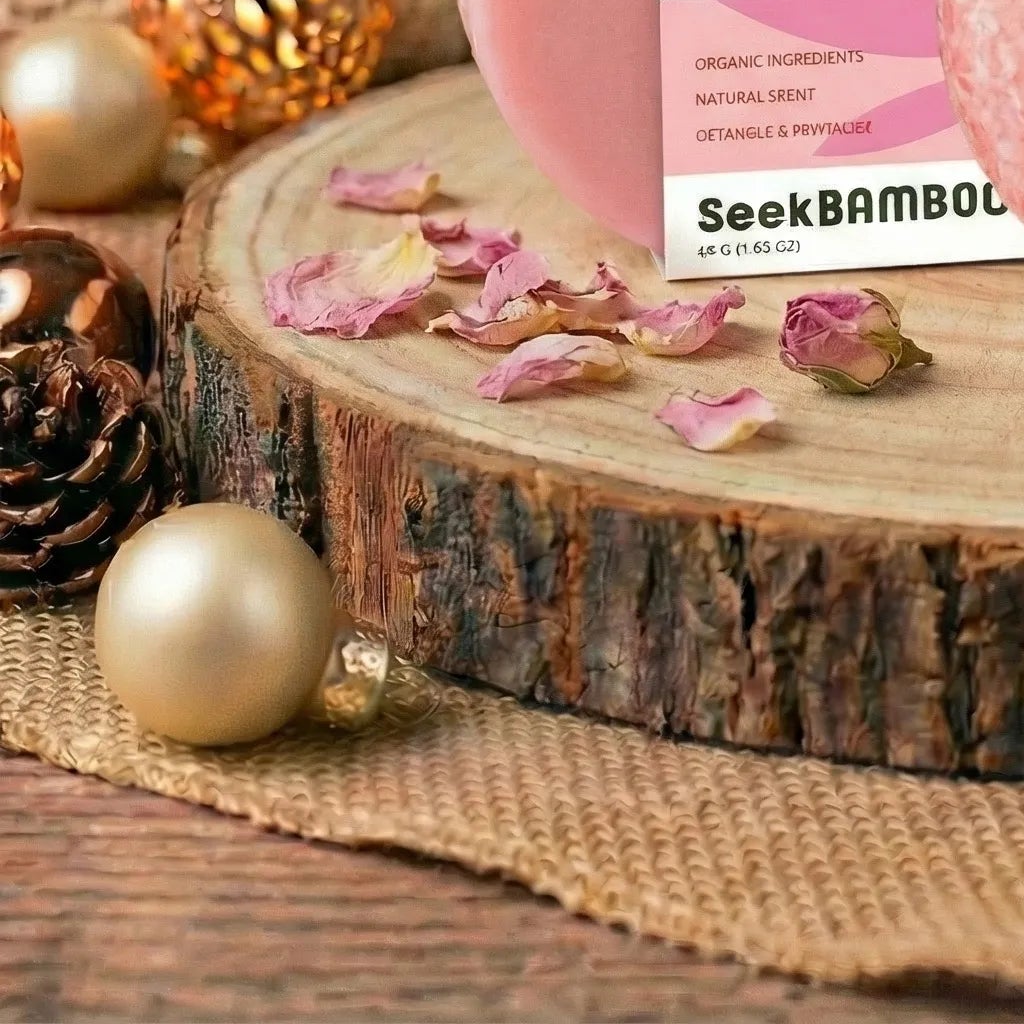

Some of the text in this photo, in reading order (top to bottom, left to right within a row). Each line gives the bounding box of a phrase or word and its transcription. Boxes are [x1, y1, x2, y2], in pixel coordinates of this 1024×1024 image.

[695, 50, 864, 71] ORGANIC INGREDIENTS
[695, 91, 765, 106] NATURAL
[777, 124, 789, 138] &
[698, 182, 1008, 233] SeekBAMBOO
[736, 241, 771, 256] (1.65
